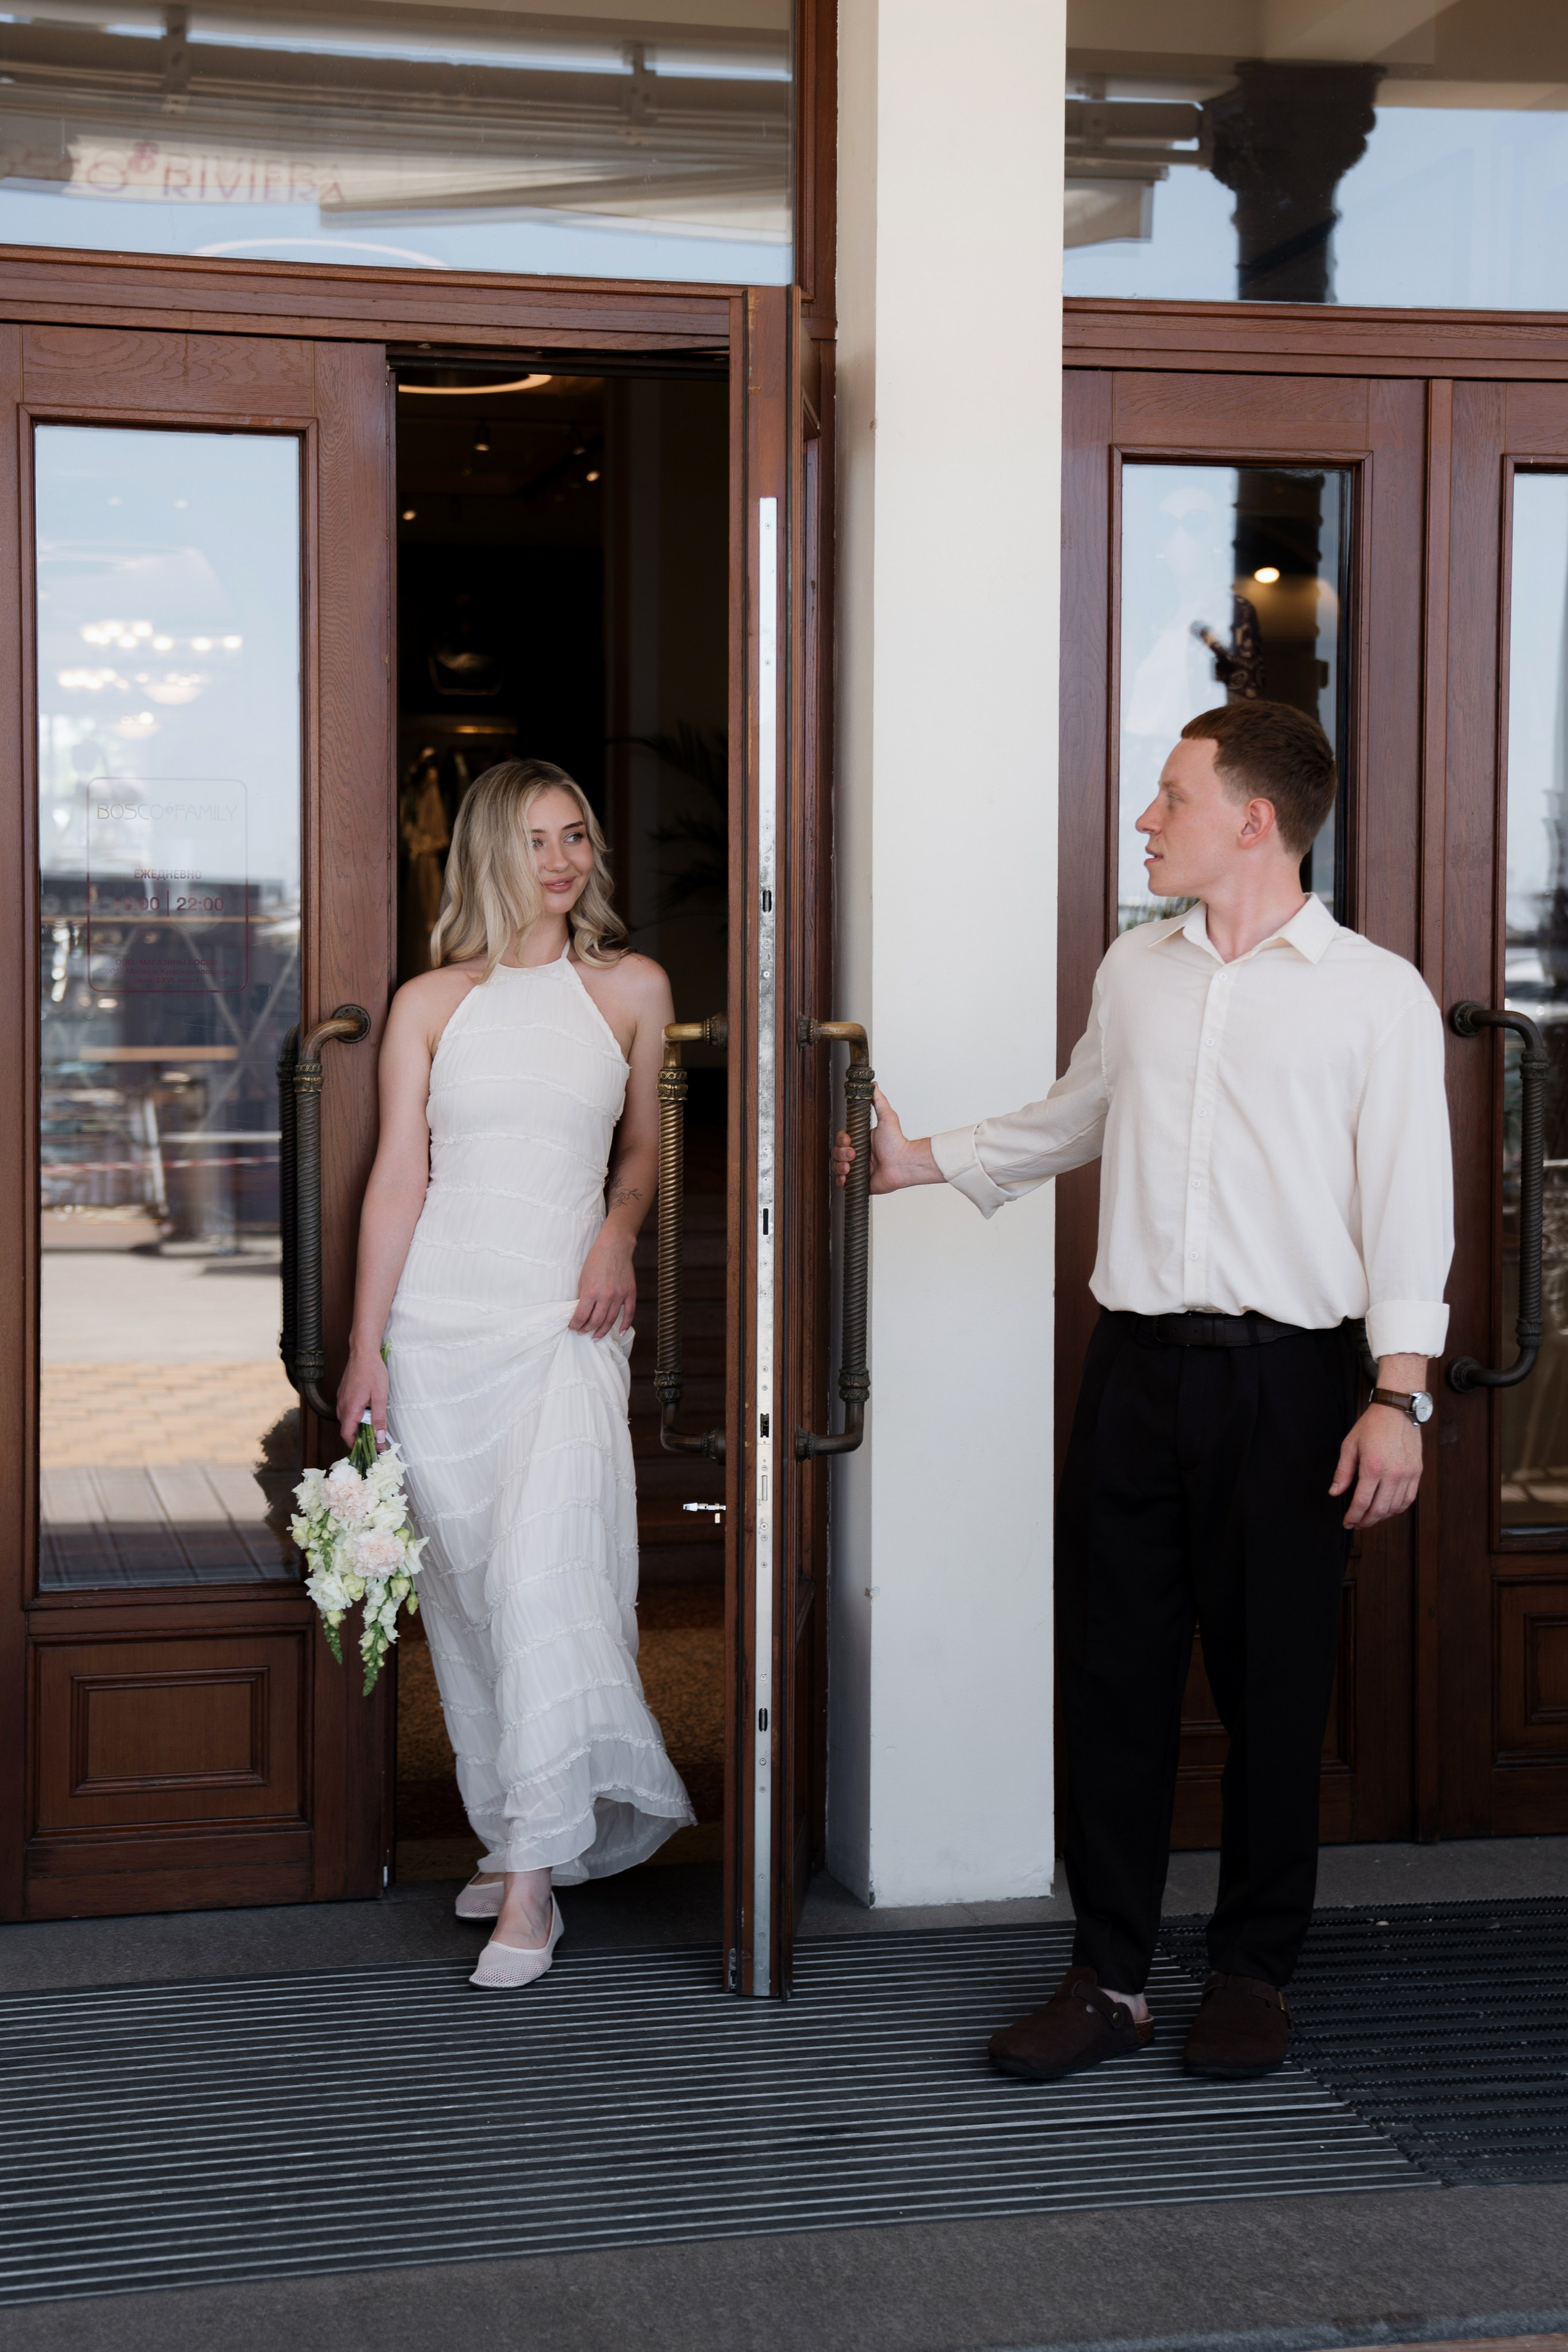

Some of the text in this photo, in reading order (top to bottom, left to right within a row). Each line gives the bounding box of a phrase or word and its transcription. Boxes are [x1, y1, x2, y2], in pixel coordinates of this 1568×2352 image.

[162, 153, 345, 203] RIVIERA
[97, 803, 238, 821] BOSCO FAMILY
[134, 869, 202, 881] ЕЖЕДНЕВНО
[113, 896, 225, 912] 10:00 22:00
